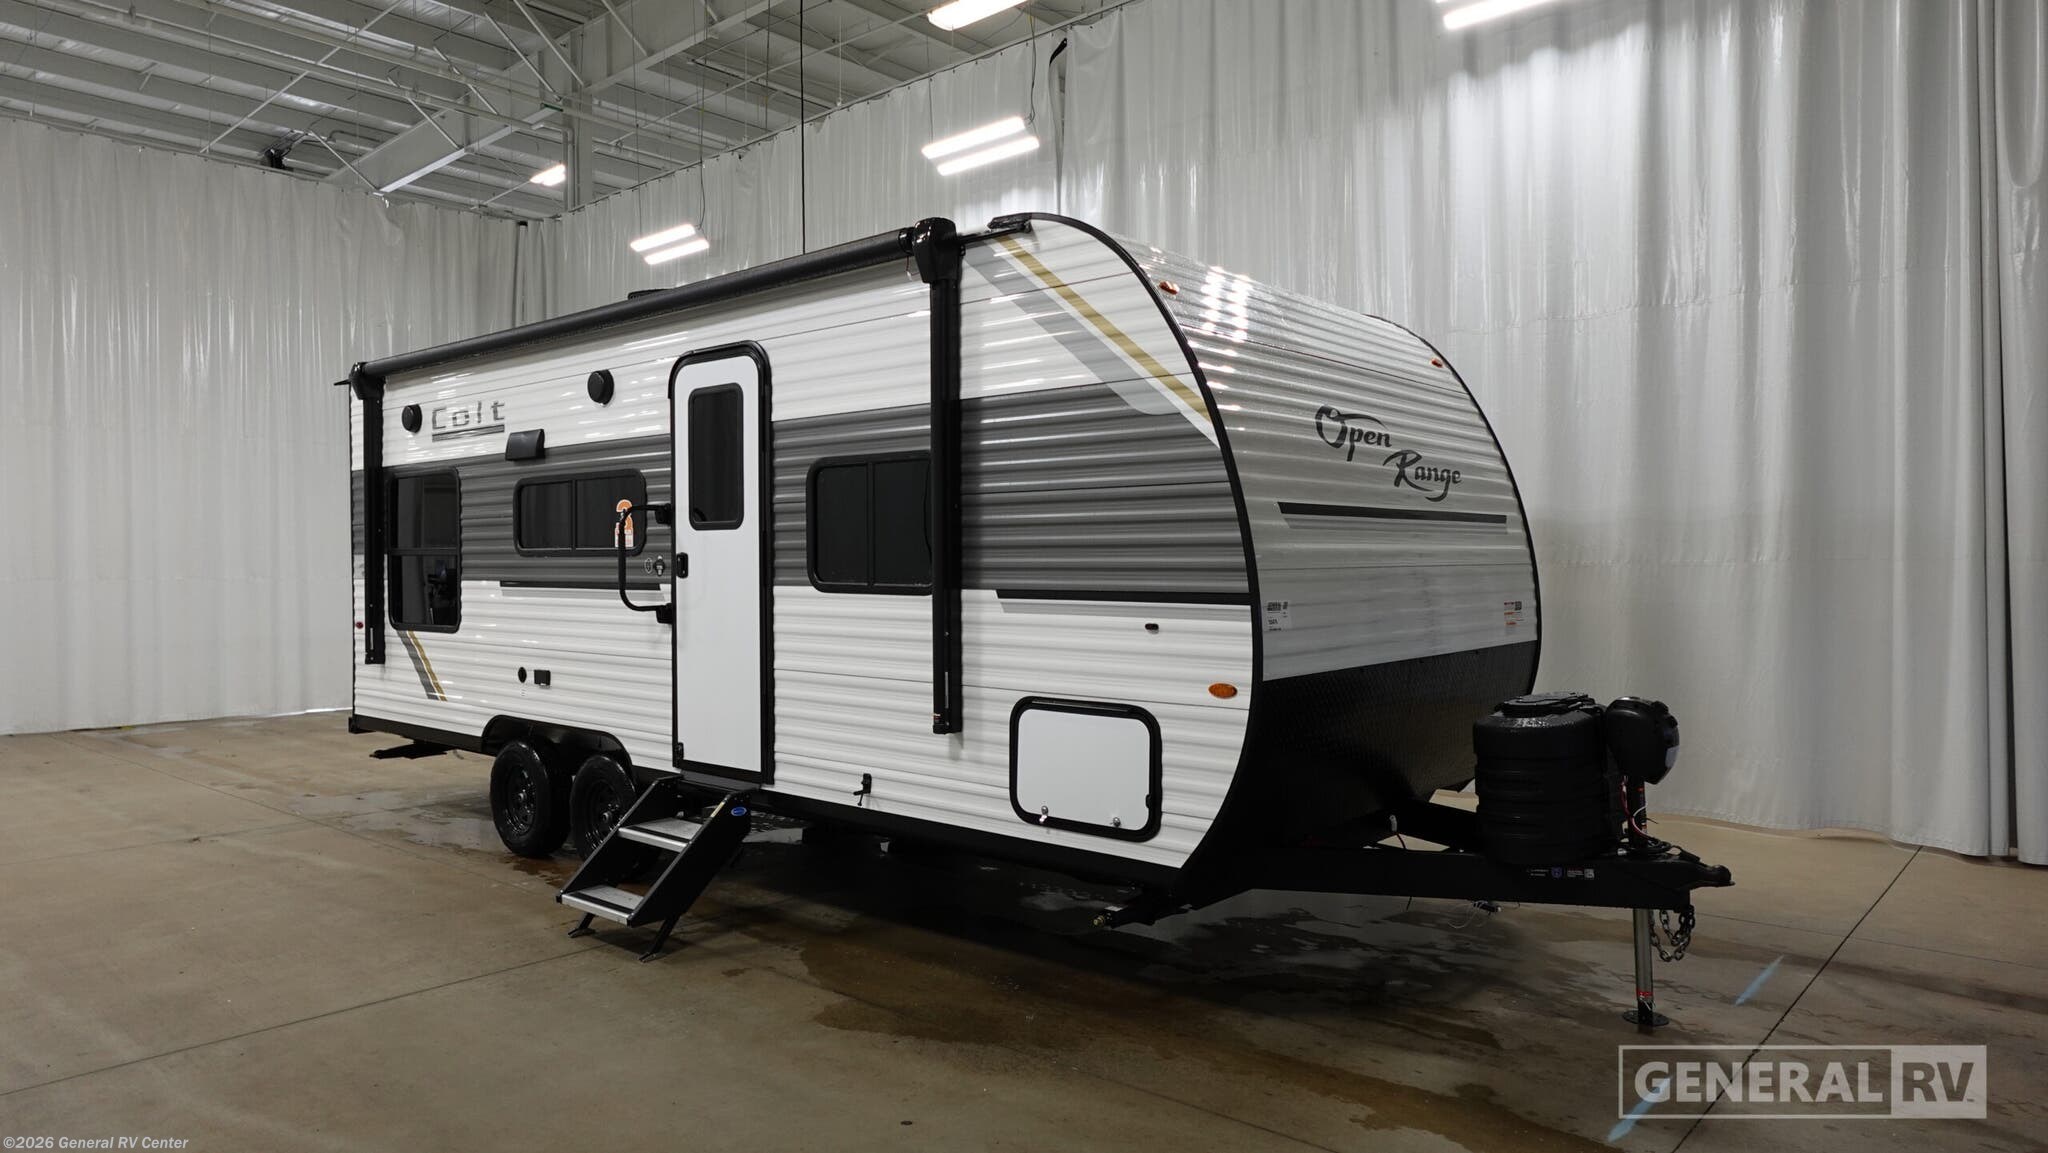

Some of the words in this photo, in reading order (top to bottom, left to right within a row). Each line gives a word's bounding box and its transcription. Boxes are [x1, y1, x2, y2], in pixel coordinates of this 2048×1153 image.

[432, 401, 505, 430] Colt
[1315, 405, 1392, 462] Open
[1382, 449, 1461, 502] Range
